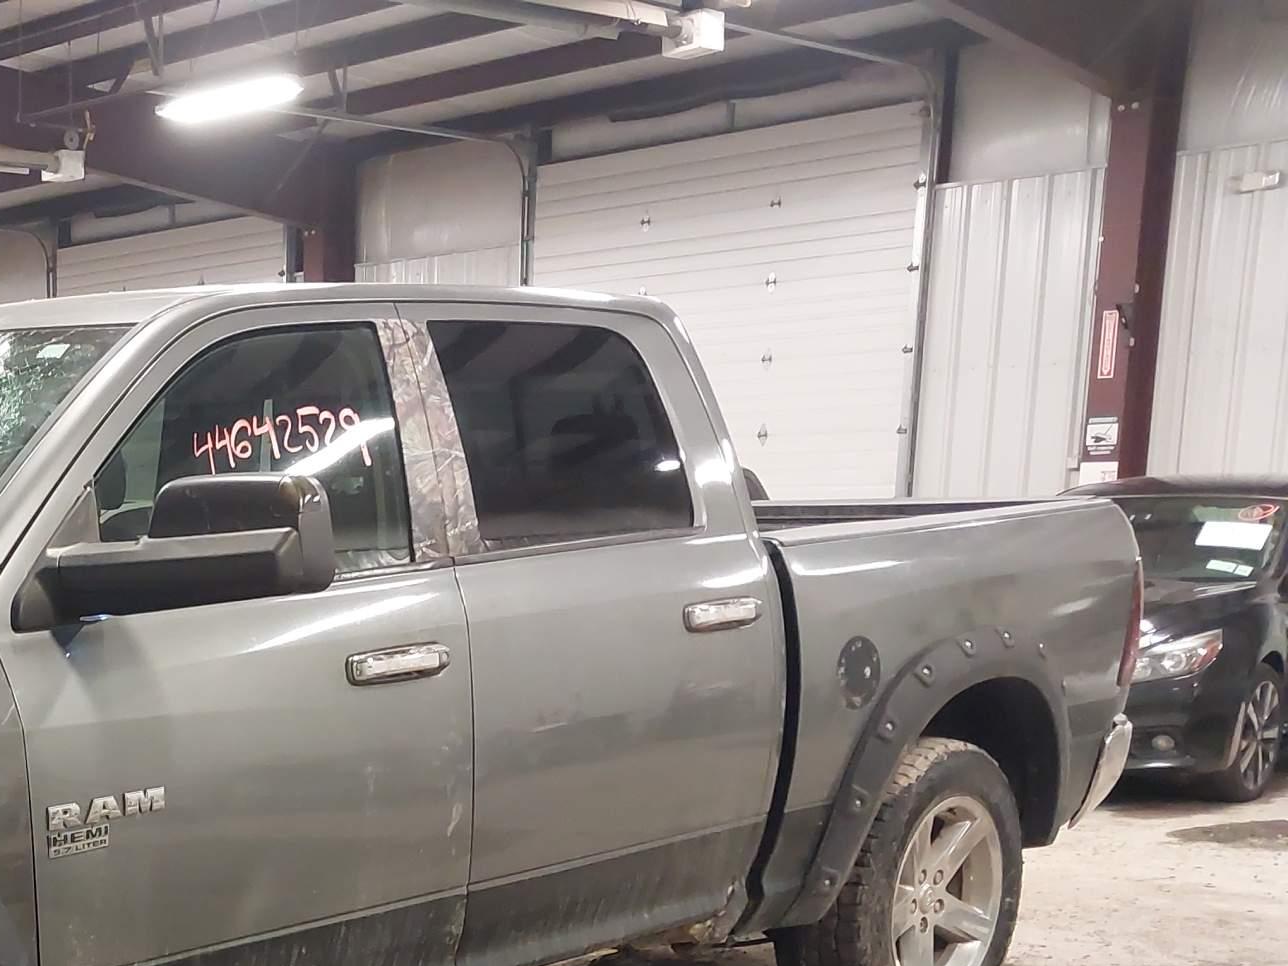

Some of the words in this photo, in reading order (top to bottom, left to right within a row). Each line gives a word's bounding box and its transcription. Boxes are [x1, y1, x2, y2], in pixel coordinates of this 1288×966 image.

[193, 405, 373, 475] 44642529
[46, 785, 166, 831] RAM
[52, 826, 109, 847] HEMI
[75, 839, 107, 851] LITER
